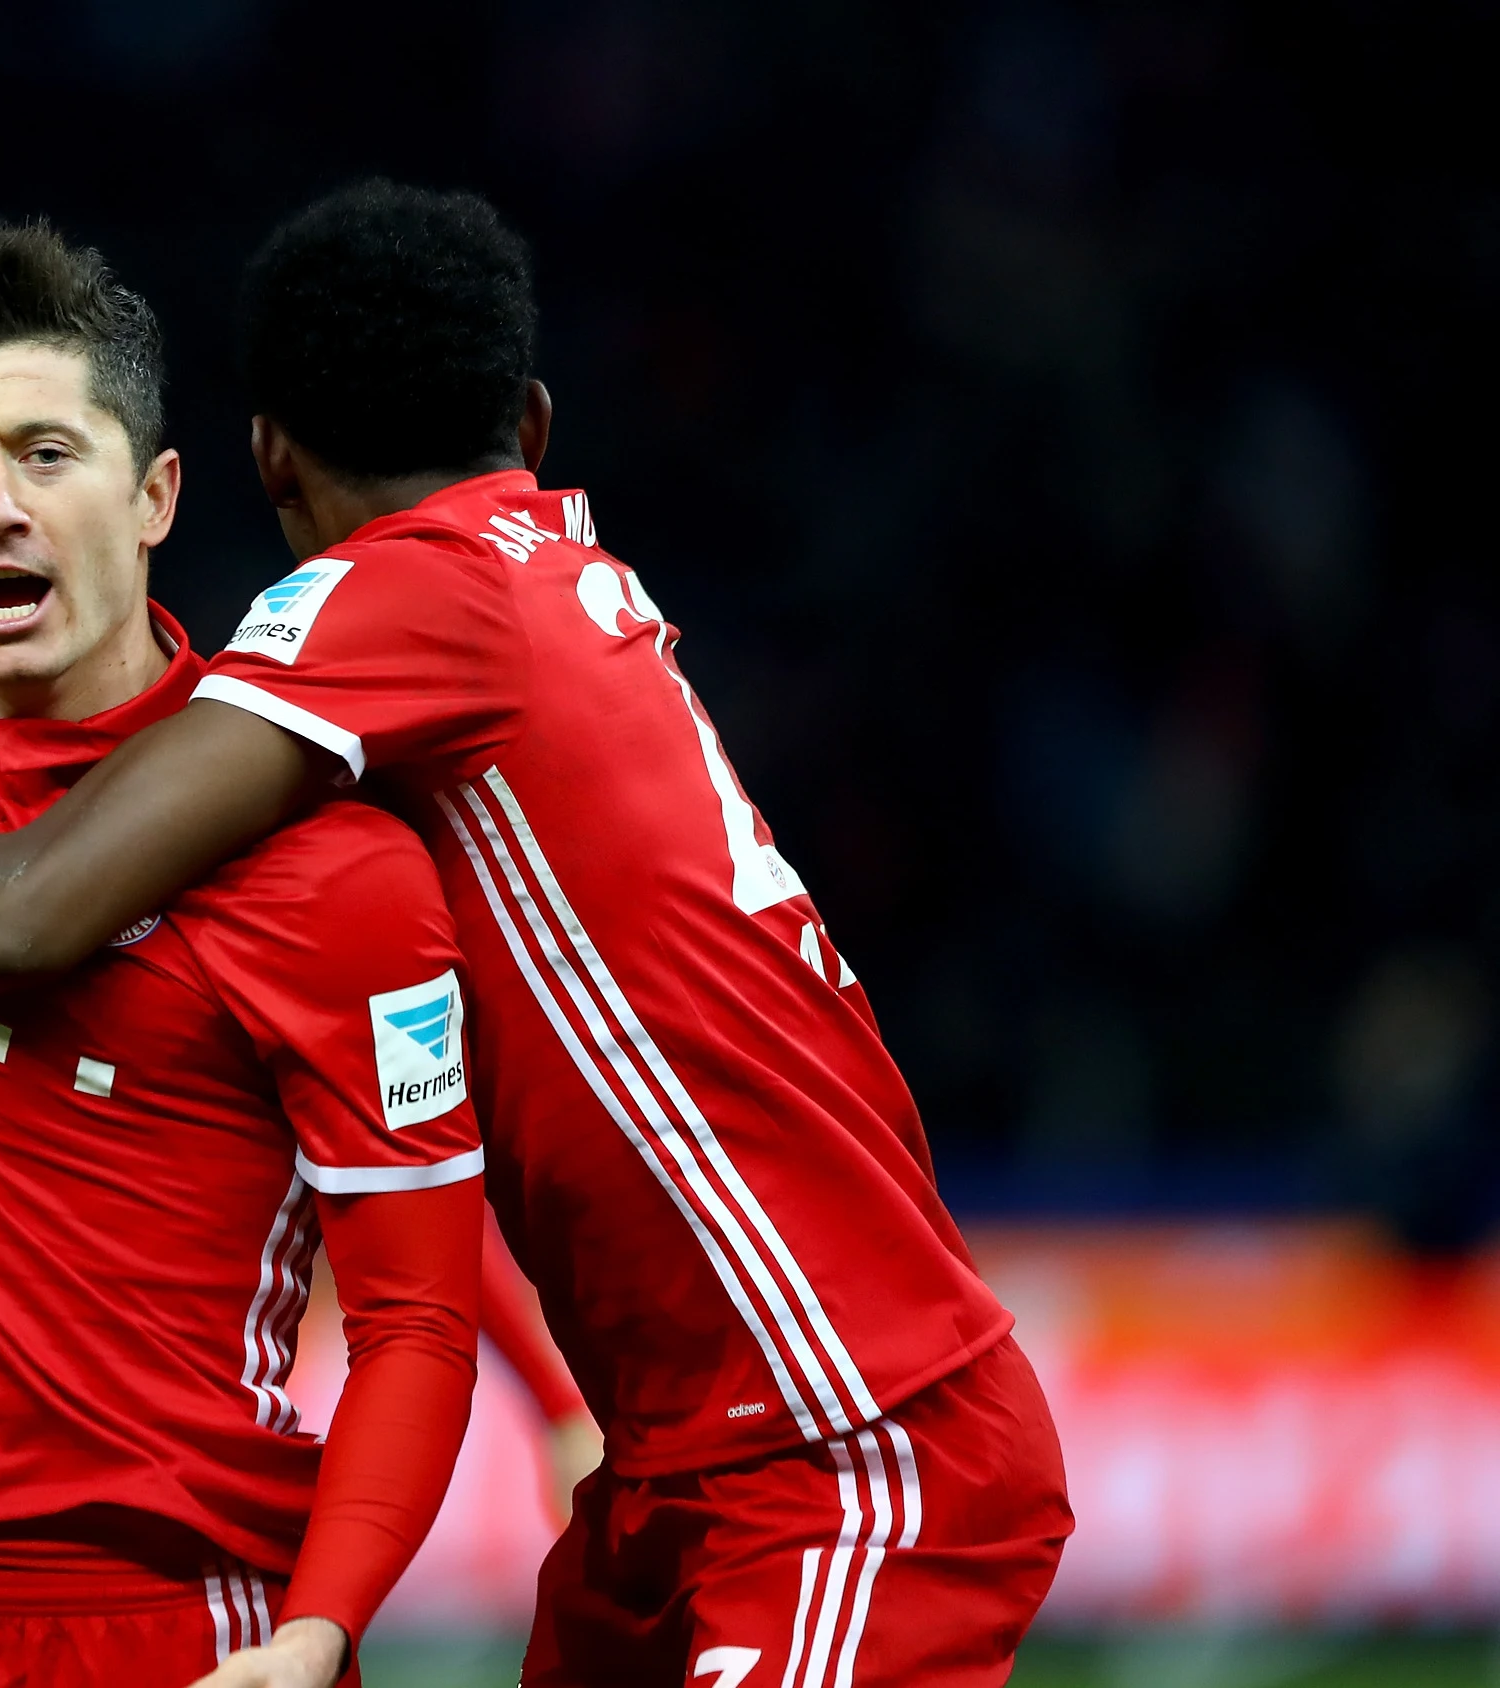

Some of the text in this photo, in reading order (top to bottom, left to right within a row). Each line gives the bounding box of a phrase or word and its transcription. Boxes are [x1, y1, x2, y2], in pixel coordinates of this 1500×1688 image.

[228, 622, 302, 645] ermes
[112, 916, 154, 942] HEN
[387, 1060, 462, 1109] Hermes
[727, 1402, 766, 1419] adizero
